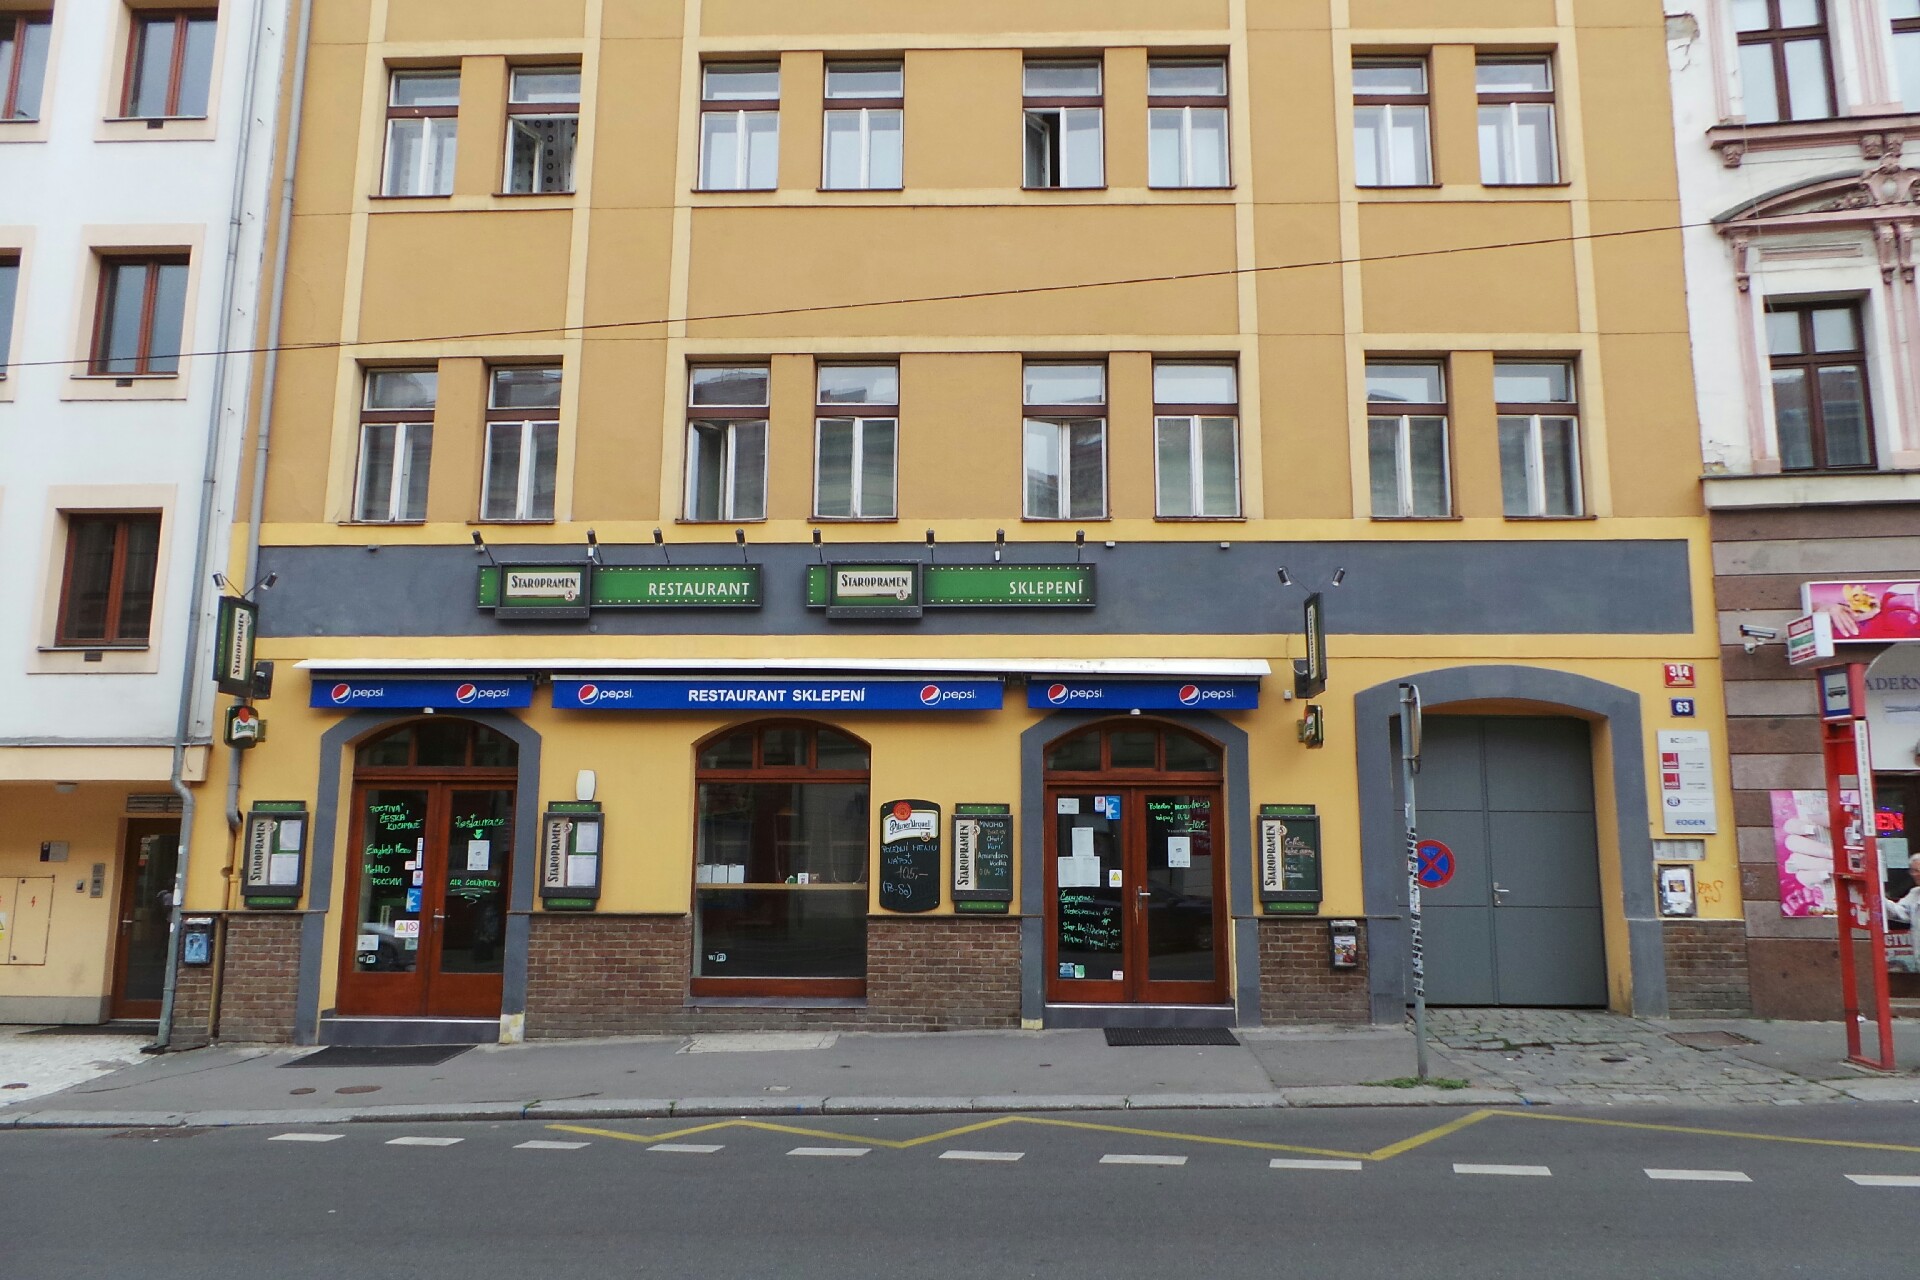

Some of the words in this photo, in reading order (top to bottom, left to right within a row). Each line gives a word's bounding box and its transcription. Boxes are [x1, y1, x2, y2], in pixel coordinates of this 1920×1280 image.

[511, 575, 577, 589] STAROPRAMEN
[841, 573, 908, 588] STAROPRAMEN
[1009, 579, 1084, 595] SKLEPENÍ
[648, 582, 750, 596] RESTAURANT
[353, 688, 384, 700] pepsi
[478, 688, 510, 700] pepsi
[600, 688, 633, 700] pepsi
[688, 689, 787, 702] RESTAURANT
[792, 687, 866, 702] SKLEPENÍ
[942, 688, 976, 701] pepsi
[1070, 688, 1103, 700] pepsi
[1202, 689, 1236, 700] pepsi
[1676, 701, 1690, 713] 63
[250, 821, 266, 881] STAROPRAMEN
[547, 822, 561, 883] STAROPRAMEN
[956, 825, 970, 886] STAROPRAMEN
[1264, 824, 1277, 886] STAROPRAMEN
